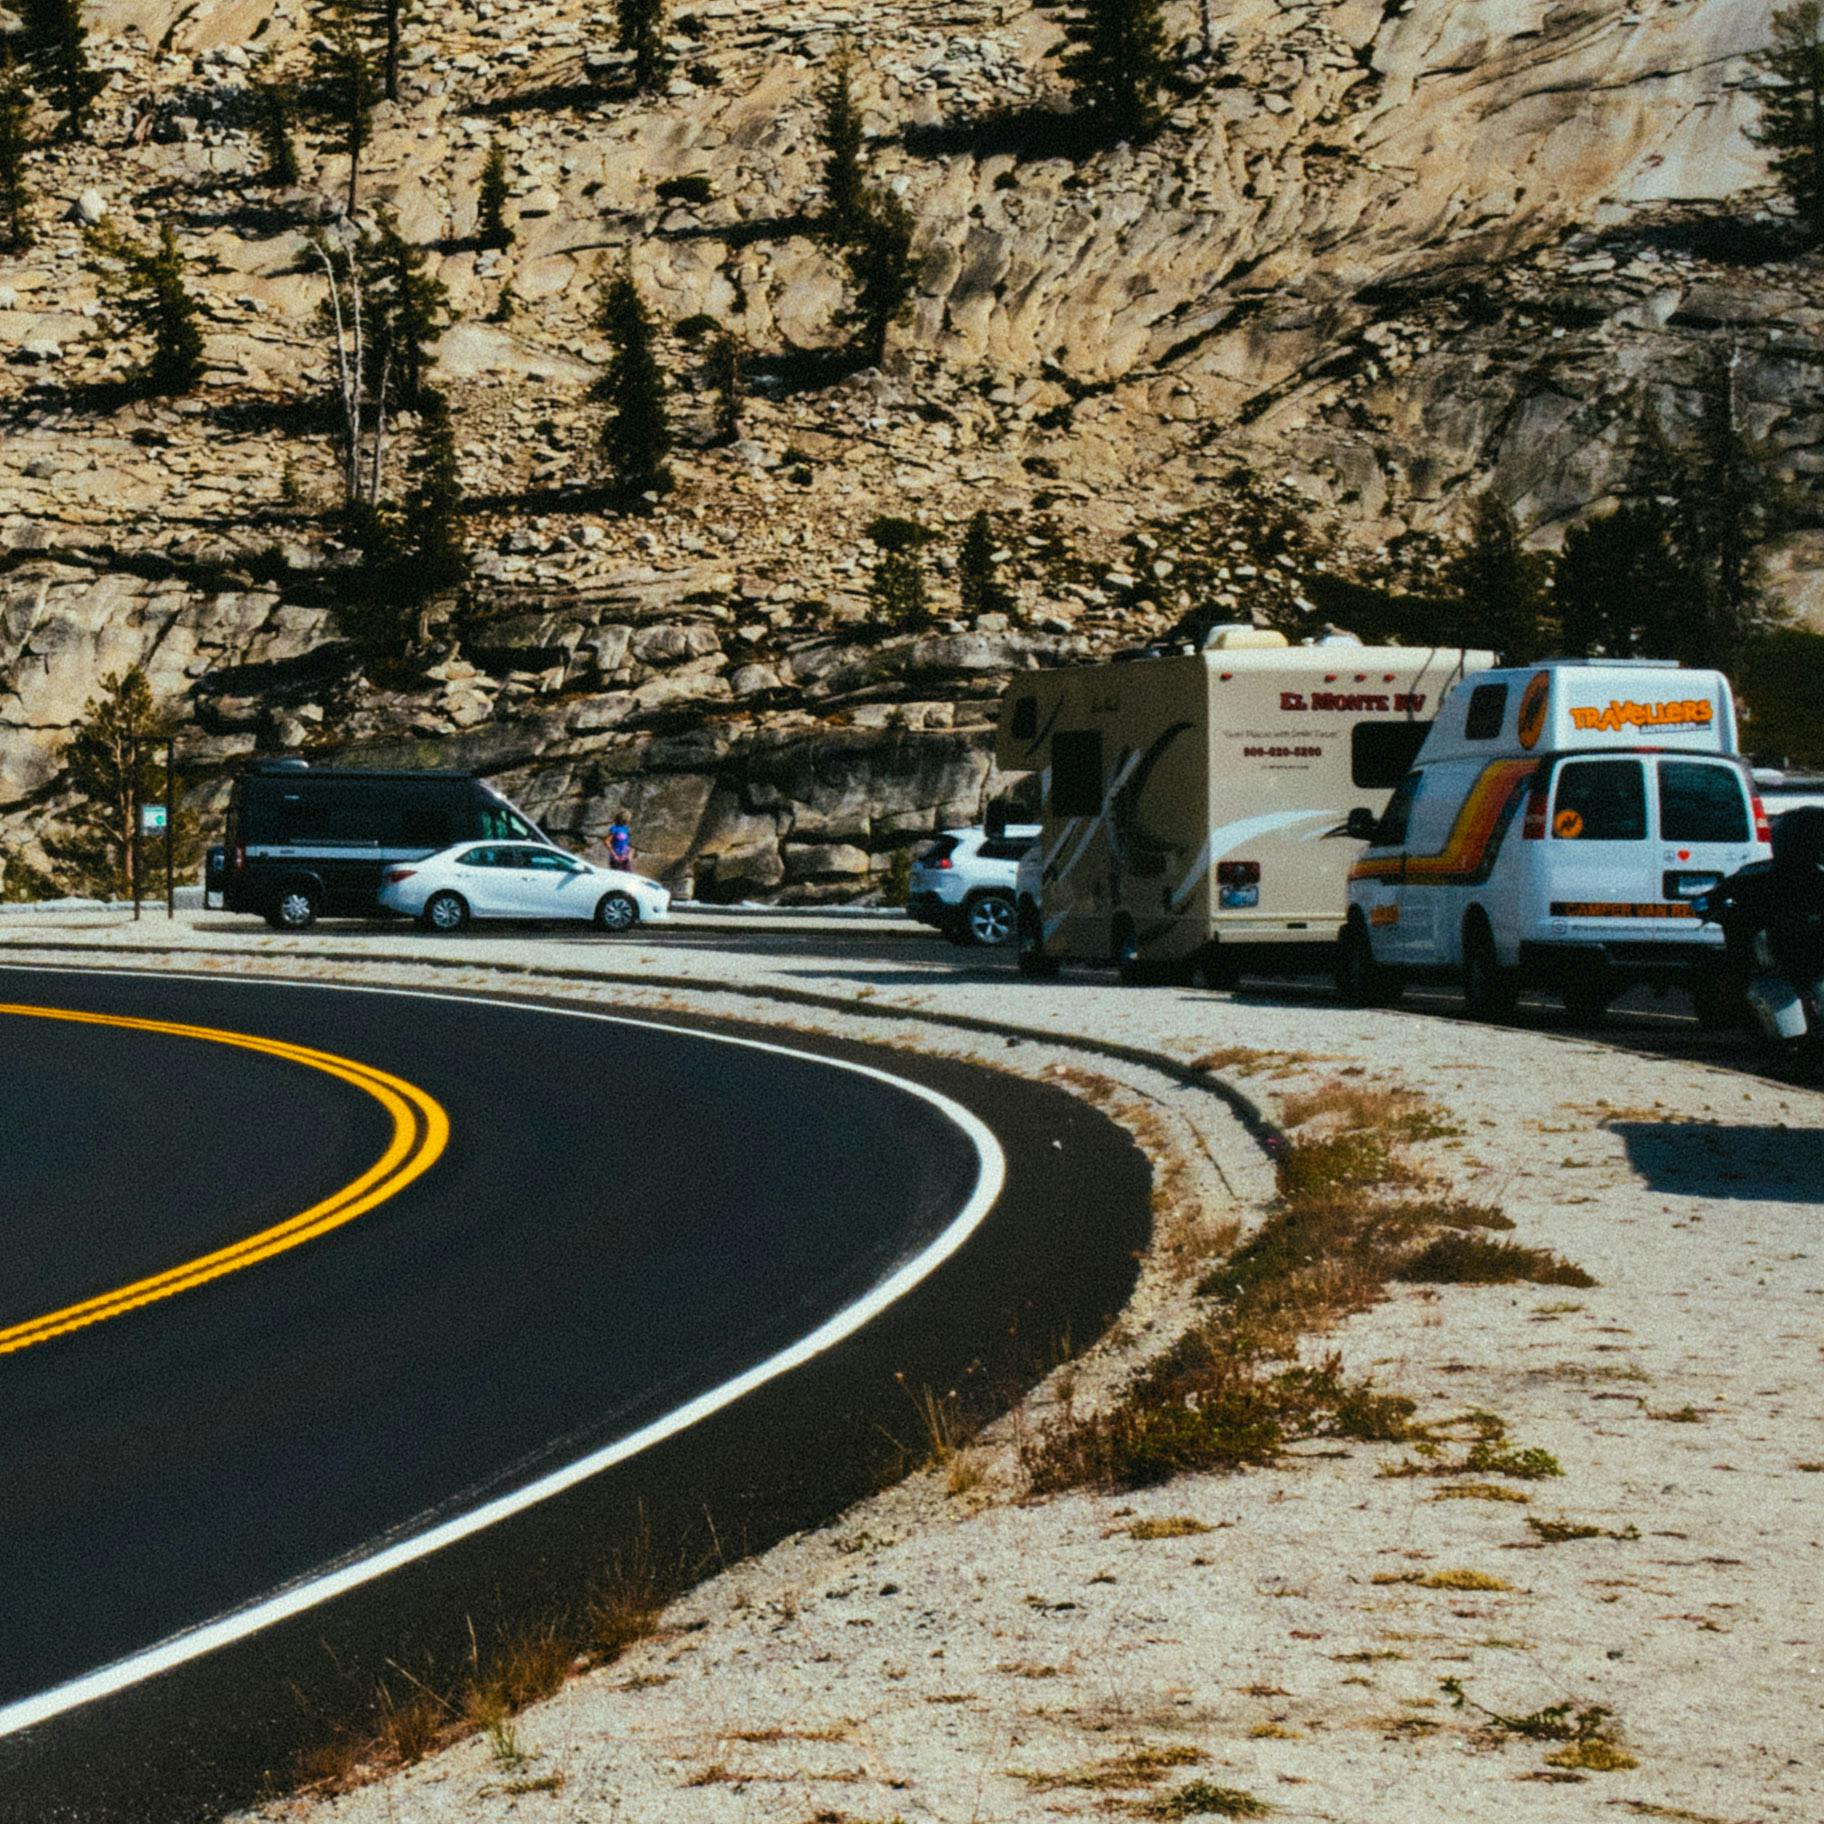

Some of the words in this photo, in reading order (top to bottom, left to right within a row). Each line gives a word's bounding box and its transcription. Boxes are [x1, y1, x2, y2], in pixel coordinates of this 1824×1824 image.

[1280, 692, 1307, 711] EL
[1311, 692, 1389, 711] MONTE
[1394, 693, 1426, 712] RV
[1566, 902, 1632, 917] CAMPER
[1637, 903, 1667, 917] VAN
